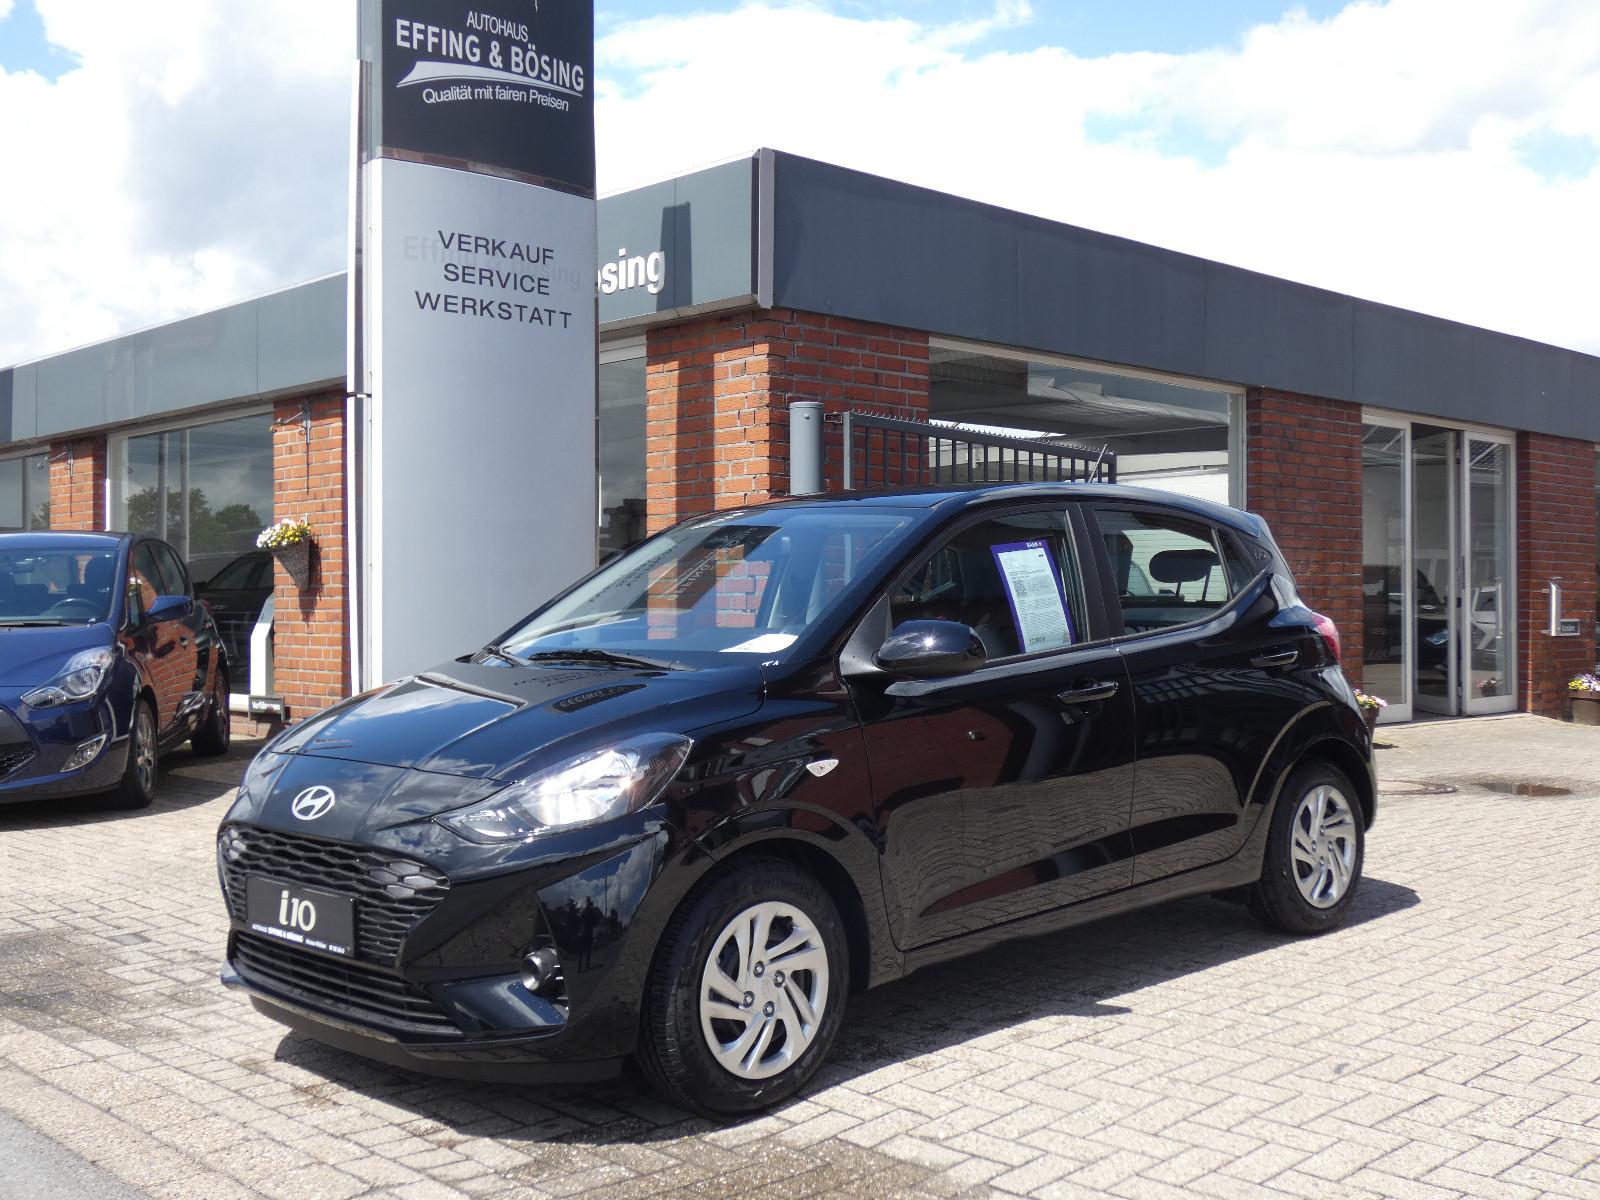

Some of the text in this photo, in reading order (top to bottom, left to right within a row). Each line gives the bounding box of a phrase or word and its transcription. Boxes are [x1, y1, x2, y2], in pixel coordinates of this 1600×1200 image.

[467, 11, 528, 42] AUTOHAUS
[396, 19, 584, 91] EFFING & BÖSING
[423, 85, 569, 111] Qualität mit fairen Preisen
[438, 230, 554, 264] VERKAUF
[443, 263, 550, 296] SERVICE
[598, 248, 665, 294] sing
[415, 291, 572, 328] WERKSTATT
[279, 890, 316, 931] i10
